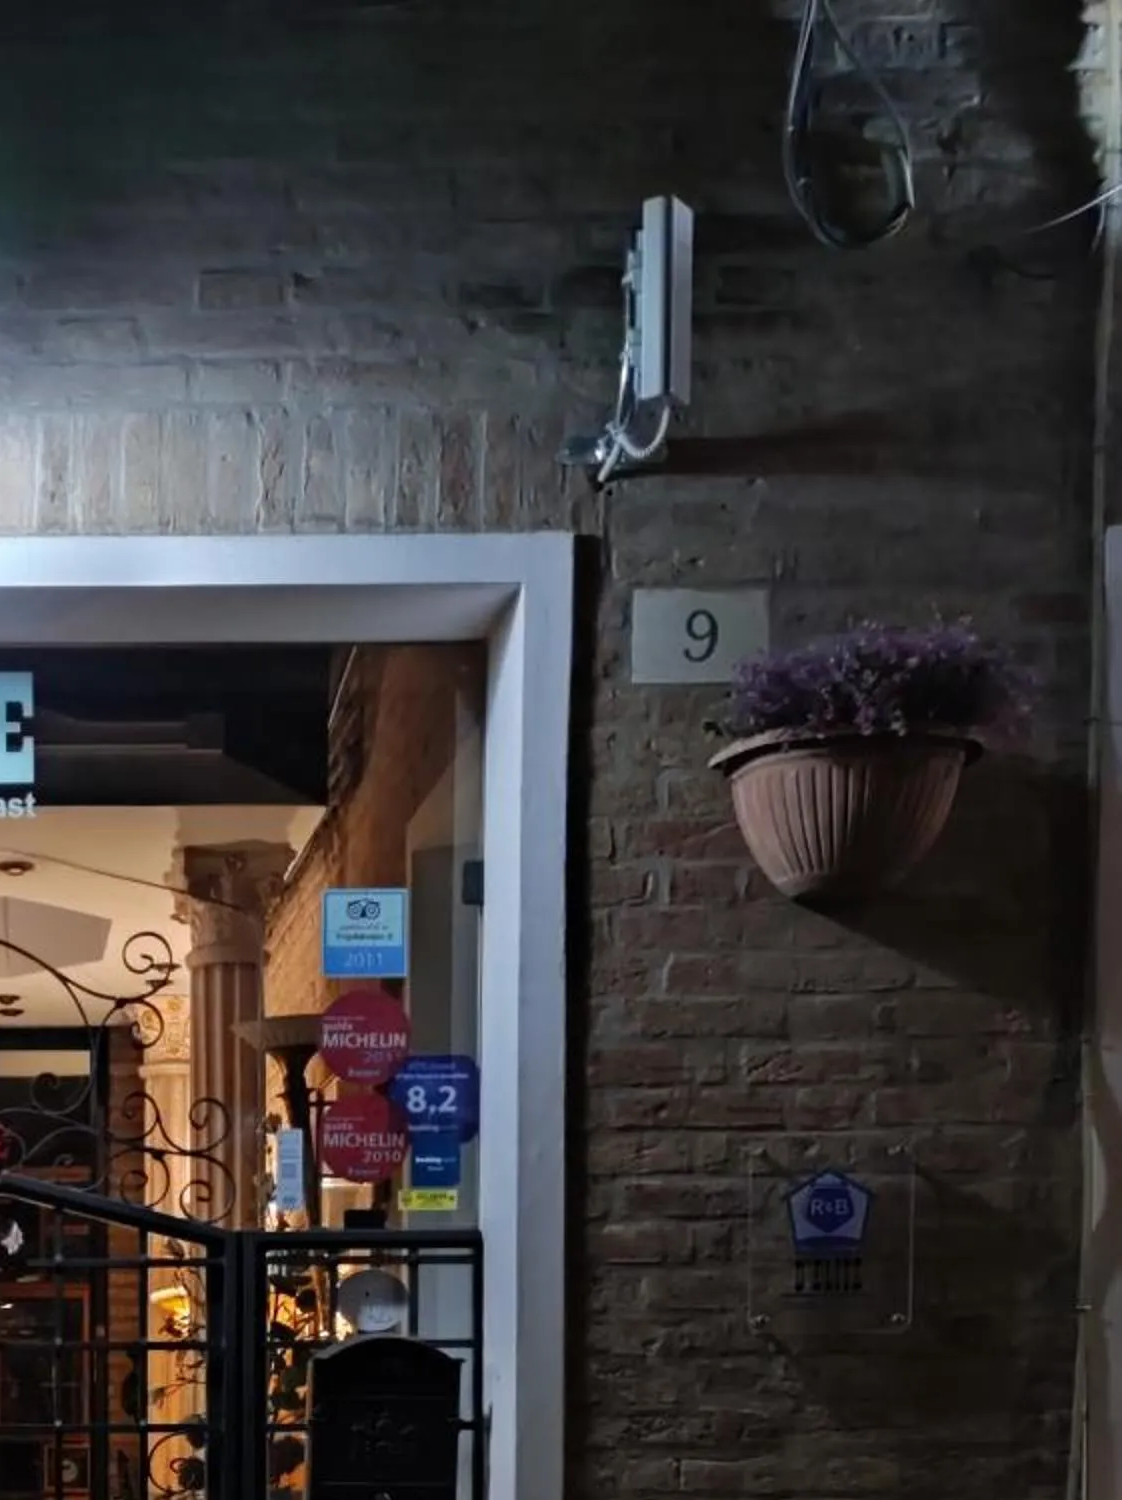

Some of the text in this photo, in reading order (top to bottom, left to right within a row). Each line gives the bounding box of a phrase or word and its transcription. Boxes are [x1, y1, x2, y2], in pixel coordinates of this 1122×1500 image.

[684, 609, 718, 663] 9
[323, 1032, 406, 1049] MICHELIN
[406, 1084, 458, 1114] 8,2
[323, 1132, 405, 1148] MICHELIN
[363, 1149, 402, 1163] 2010
